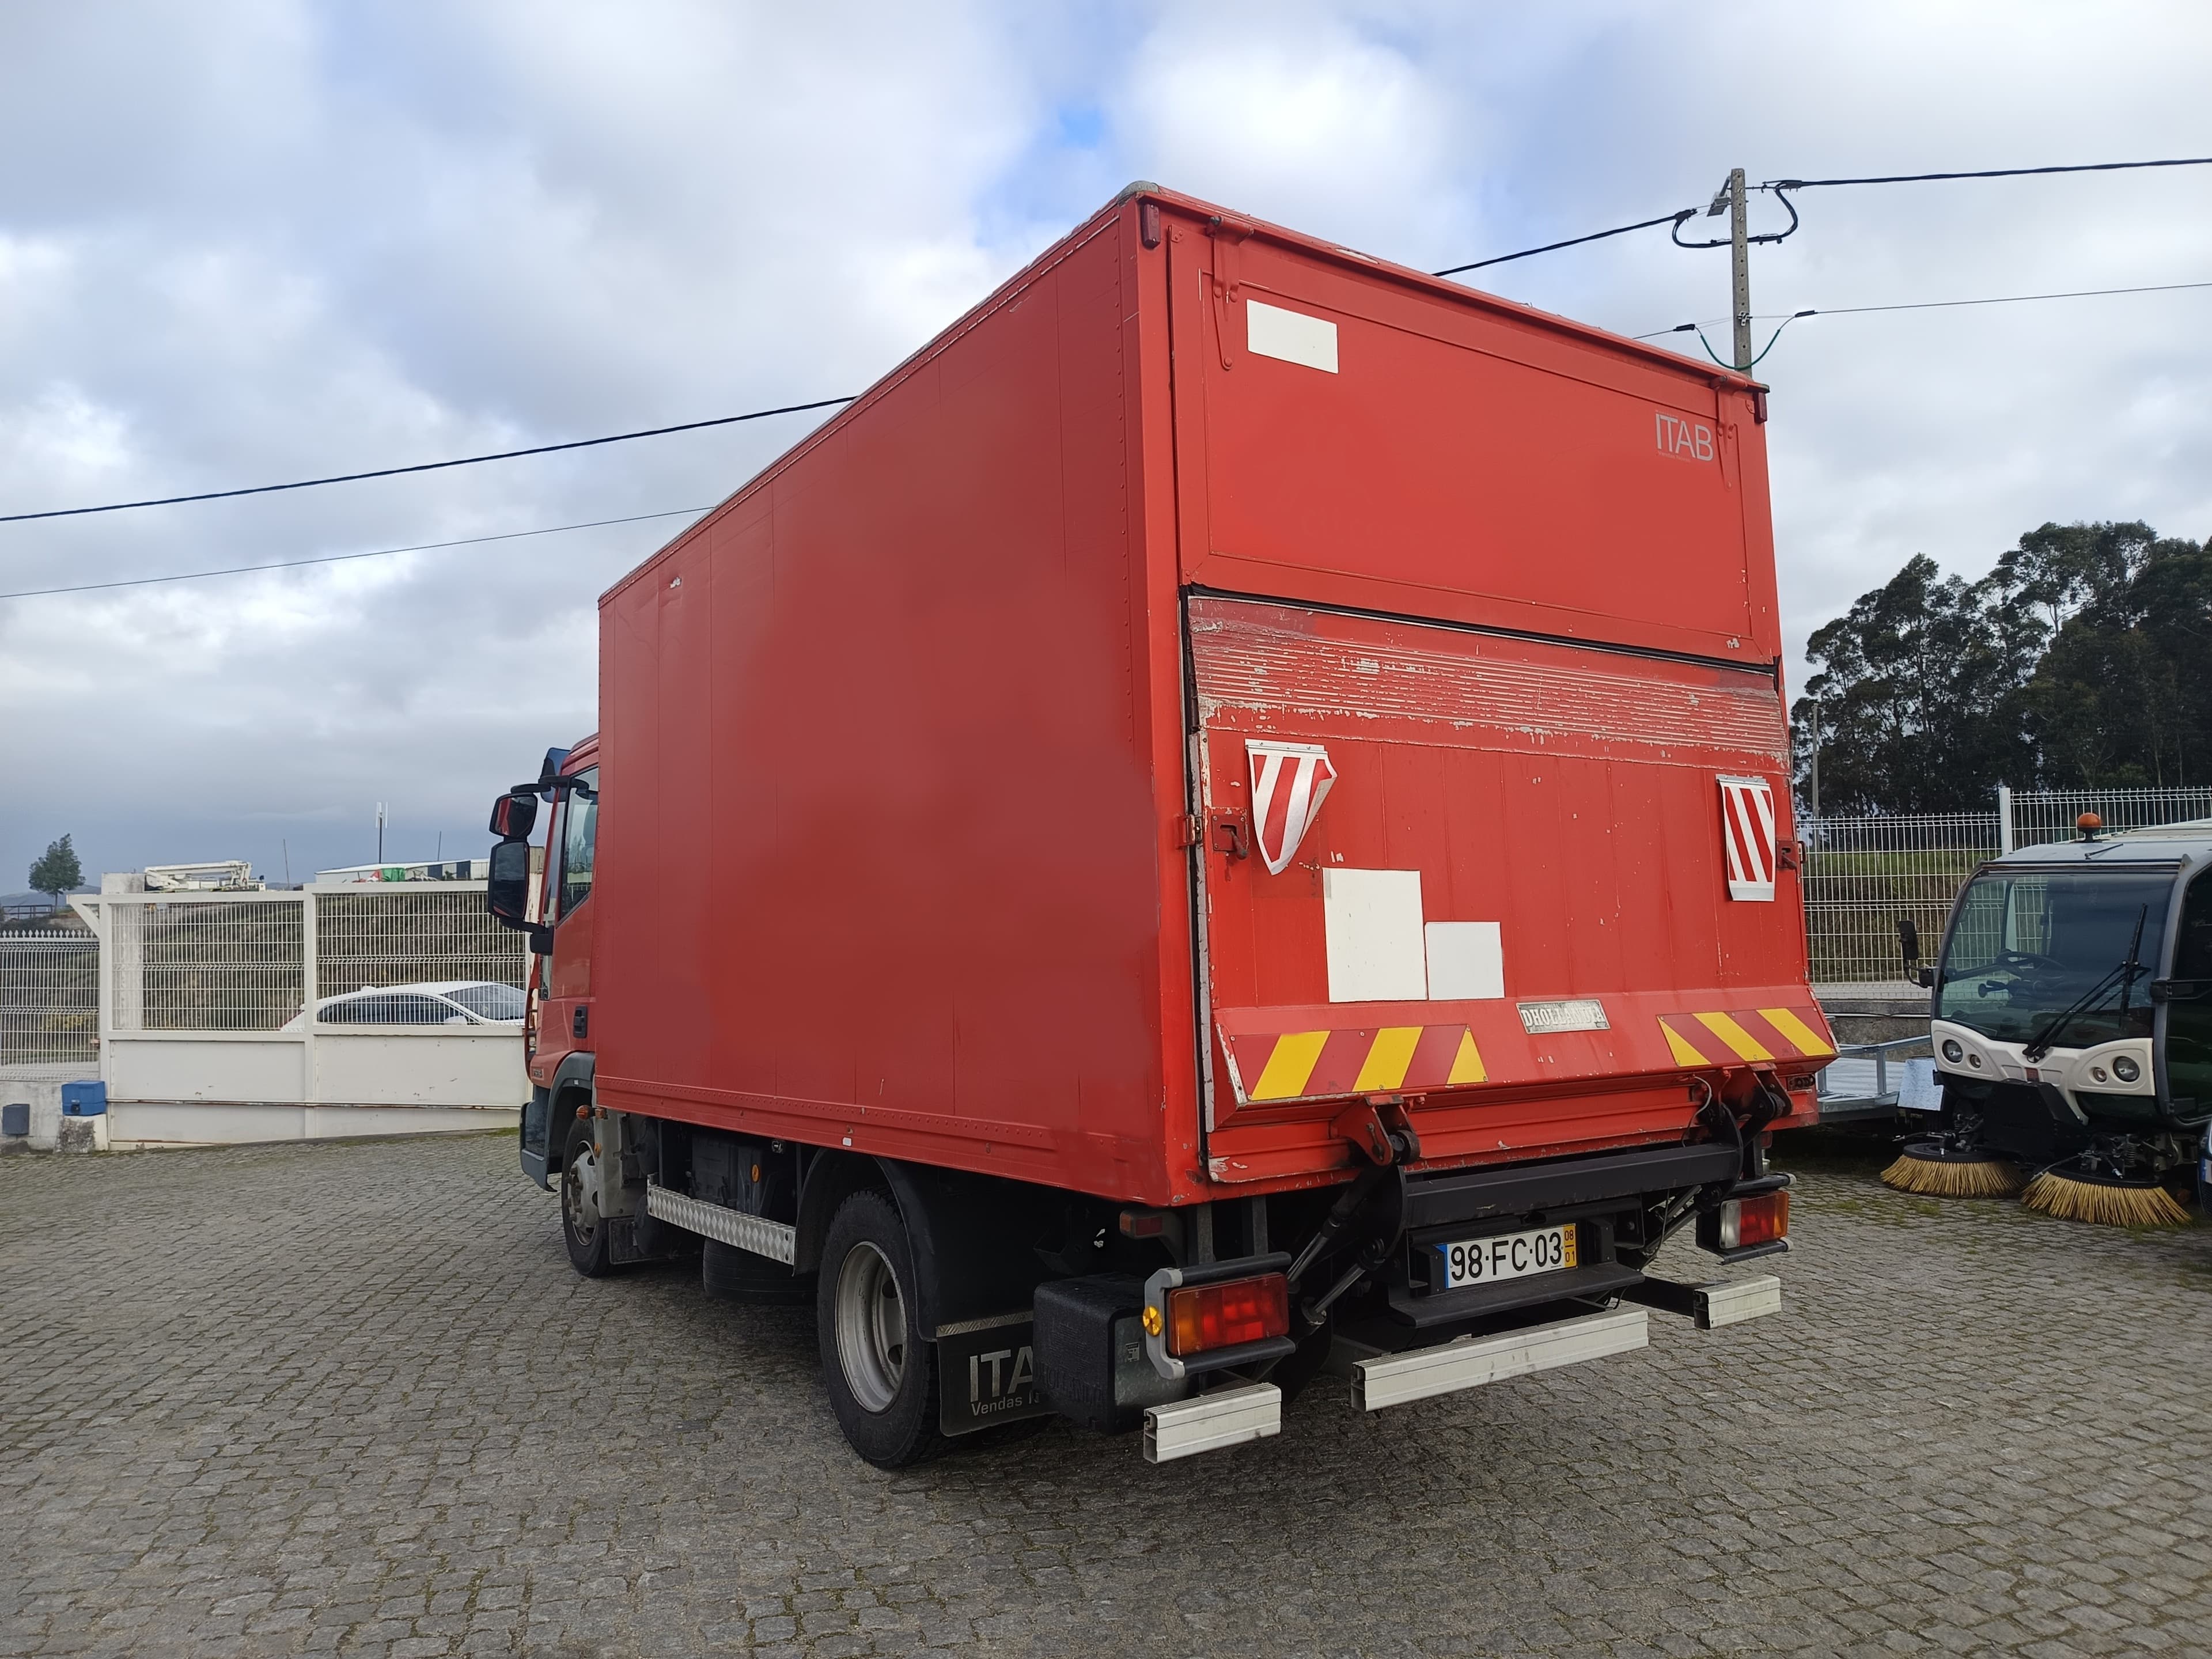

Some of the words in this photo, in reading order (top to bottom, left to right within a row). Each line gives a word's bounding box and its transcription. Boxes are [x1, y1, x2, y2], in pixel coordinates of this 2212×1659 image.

[1656, 413, 1714, 461] ITAB
[1520, 1007, 1606, 1026] DHOLLANDIA
[1565, 1229, 1574, 1241] 08
[969, 1346, 1033, 1403] ITA
[971, 1396, 1022, 1416] Vendas
